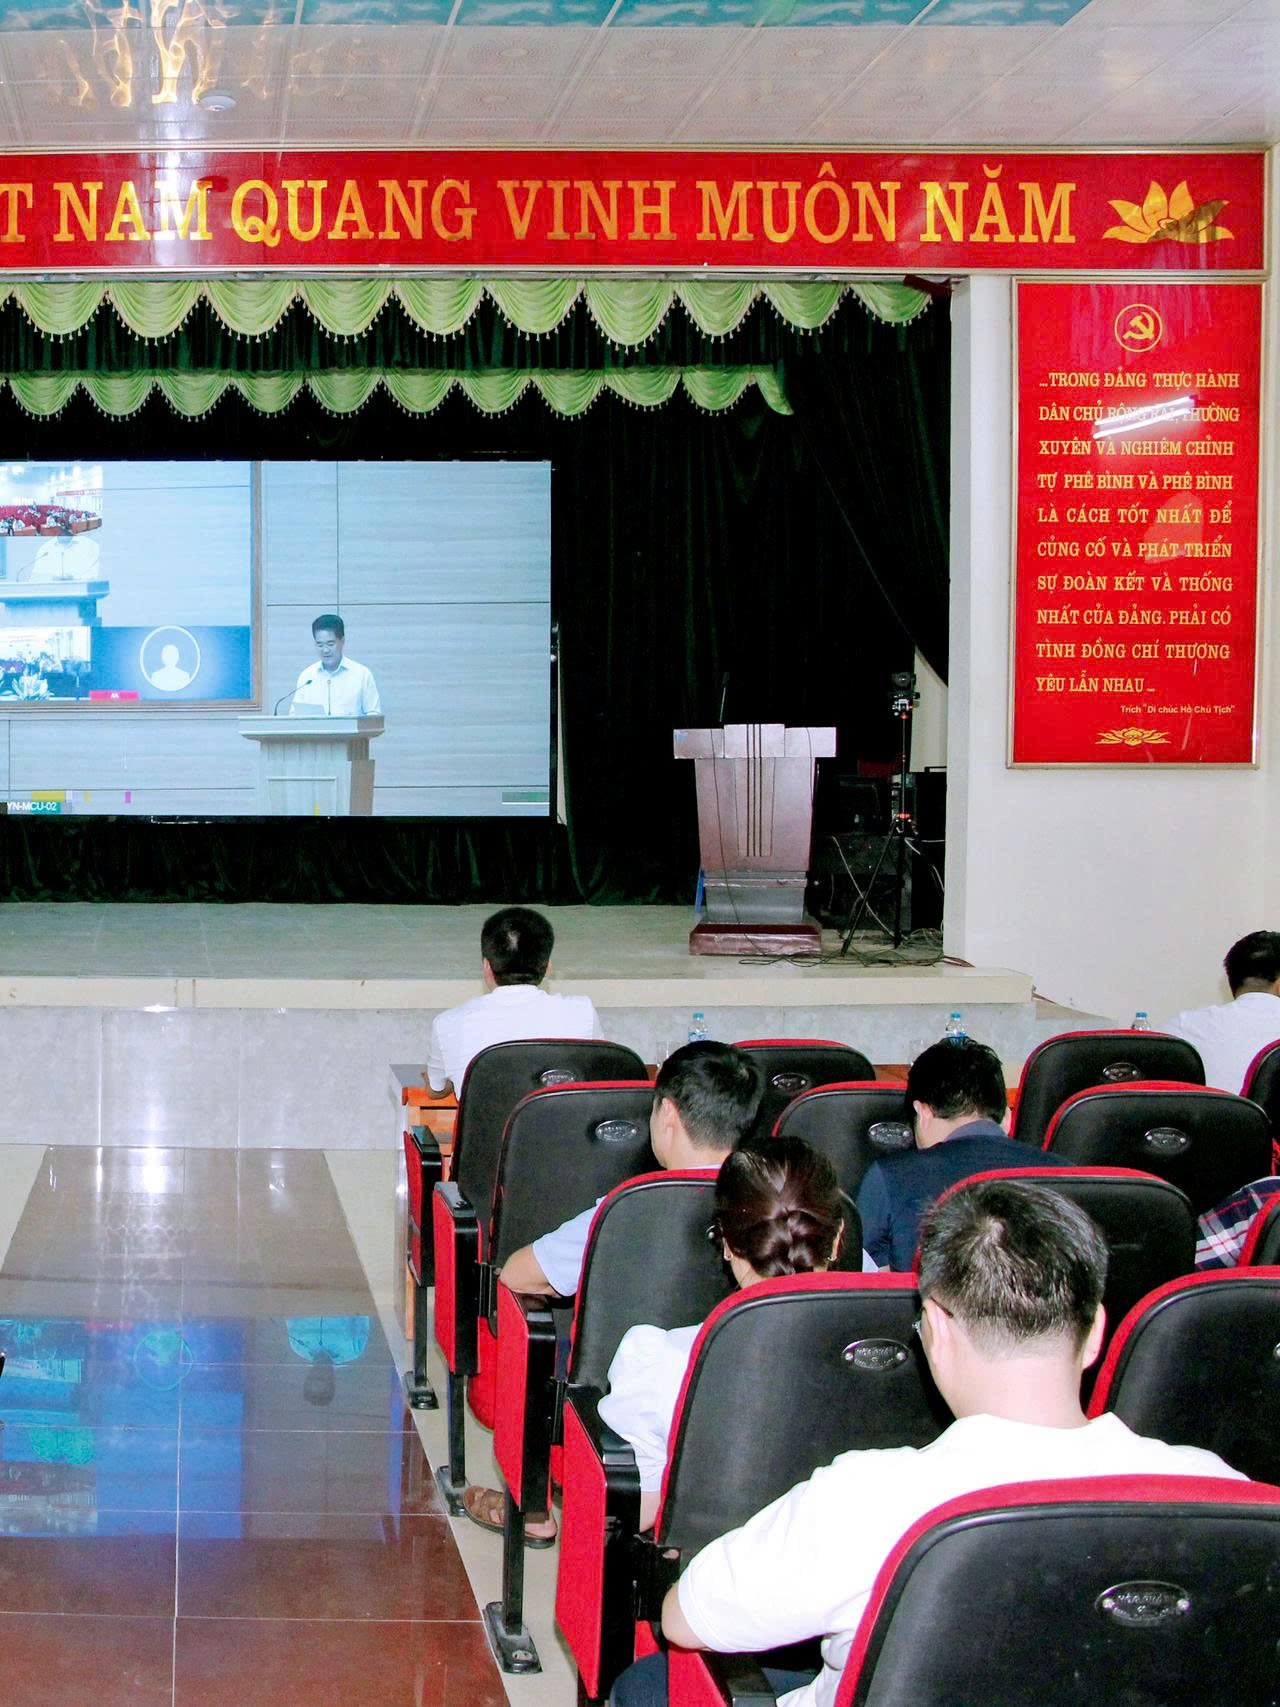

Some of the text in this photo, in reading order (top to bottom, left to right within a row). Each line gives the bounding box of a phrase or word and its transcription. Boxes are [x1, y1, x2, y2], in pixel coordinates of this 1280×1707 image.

[54, 179, 213, 244] NAM
[230, 178, 476, 248] QUANG
[497, 179, 677, 243] VINH
[696, 161, 900, 245] MUÔN
[920, 166, 1077, 245] NĂM
[1104, 365, 1146, 387] ĐẢNG
[1153, 371, 1192, 391] THỰC
[1196, 368, 1240, 388] HÀNH
[1039, 402, 1070, 421] DÂN
[1073, 399, 1103, 421] CHỦ
[1039, 434, 1234, 455] XUYÊN VÀ NGHIÊM CHỈNH
[1037, 470, 1232, 492] TỰ PHÊ BÌNH VÀ PHÊ BÌNH
[1037, 500, 1232, 524] LÀ CÁCH TỐT NHẤT ĐỂ
[1037, 535, 1232, 557] CỦNG CỐ VÀ PHÁT TRIỂN
[1037, 570, 1232, 595] SỰ ĐOÀN KẾT VÀ THỐNG
[1037, 604, 1079, 624] NHẤT
[1083, 603, 1113, 624] CỦA
[1169, 603, 1206, 624] PHẢI
[1211, 606, 1232, 624] CÓ
[1036, 637, 1230, 659] TÌNH ĐỒNG CHÍ THƯƠNG
[1036, 673, 1065, 692] YÊU
[1069, 670, 1099, 692] LẪN
